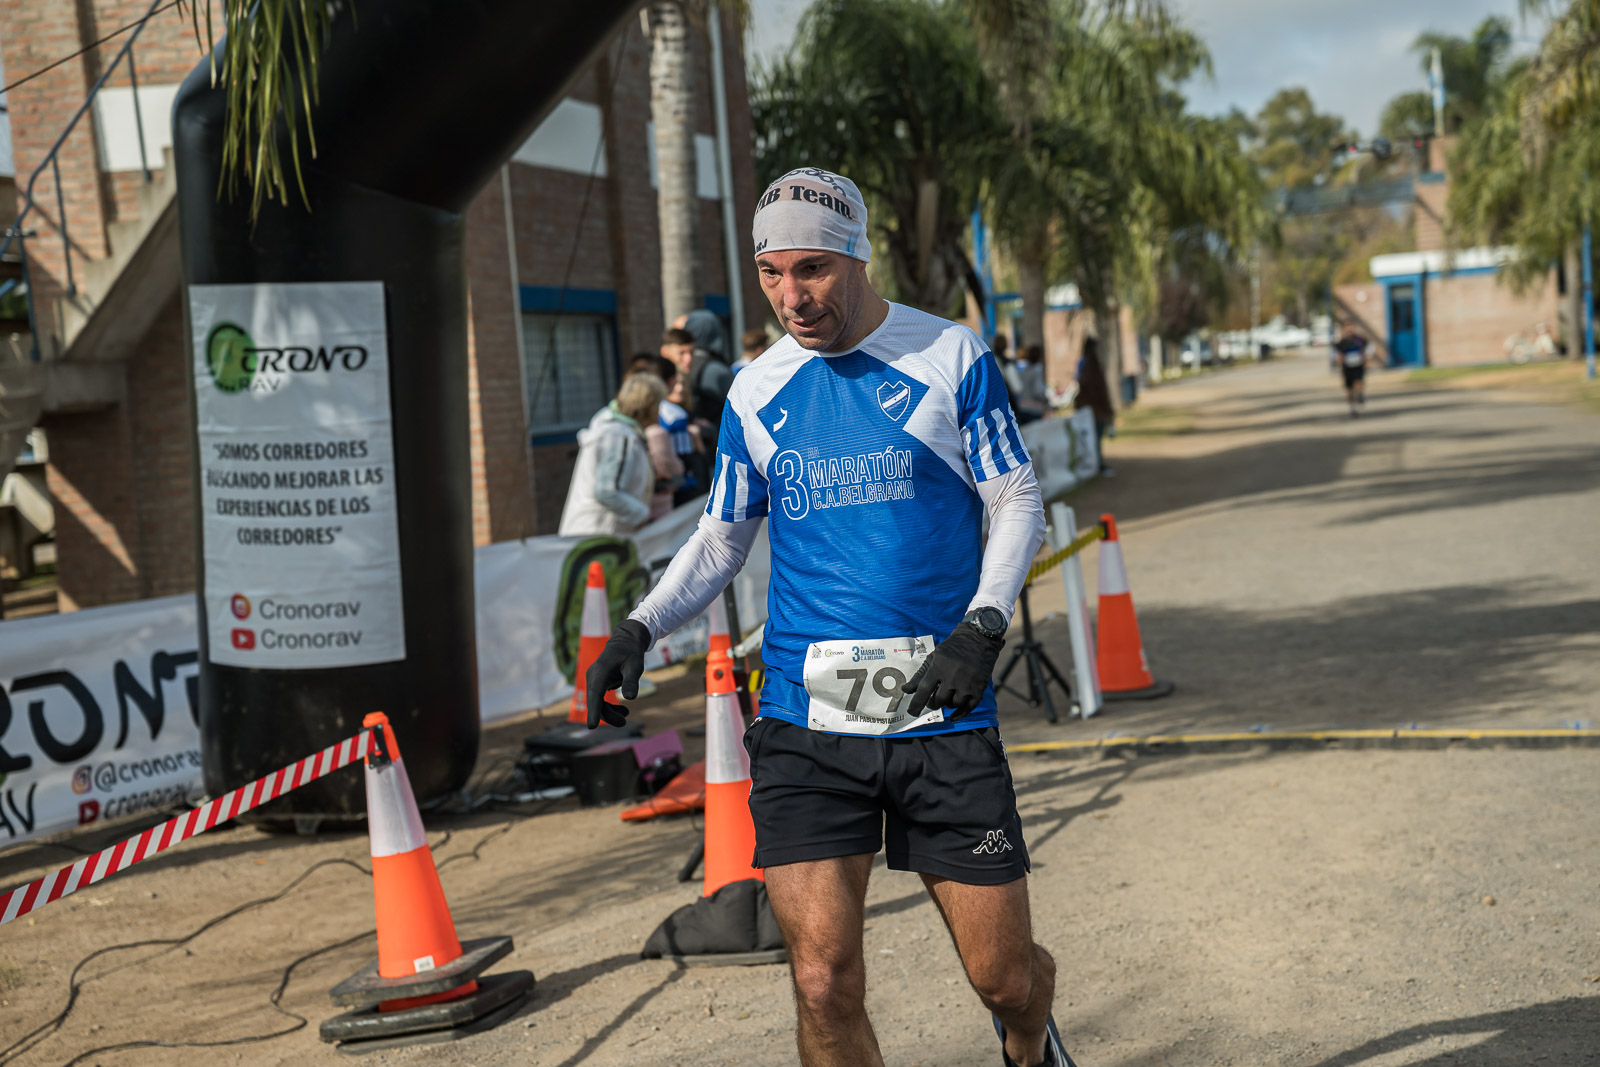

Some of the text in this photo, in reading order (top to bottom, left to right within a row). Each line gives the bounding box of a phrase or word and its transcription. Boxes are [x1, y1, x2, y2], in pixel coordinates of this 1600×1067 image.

[262, 440, 368, 461] CORREDORES
[274, 469, 351, 489] MEJORAR
[354, 467, 384, 486] LAS
[807, 446, 913, 489] MARATÓN
[775, 449, 809, 520] 3
[811, 480, 915, 510] C.A.BELGRANO
[216, 496, 370, 517] EXPERIENCIAS DE LOS
[259, 599, 361, 620] Cronorav
[261, 628, 362, 650] Cronorav
[851, 645, 860, 663] 3
[836, 666, 906, 713] 79
